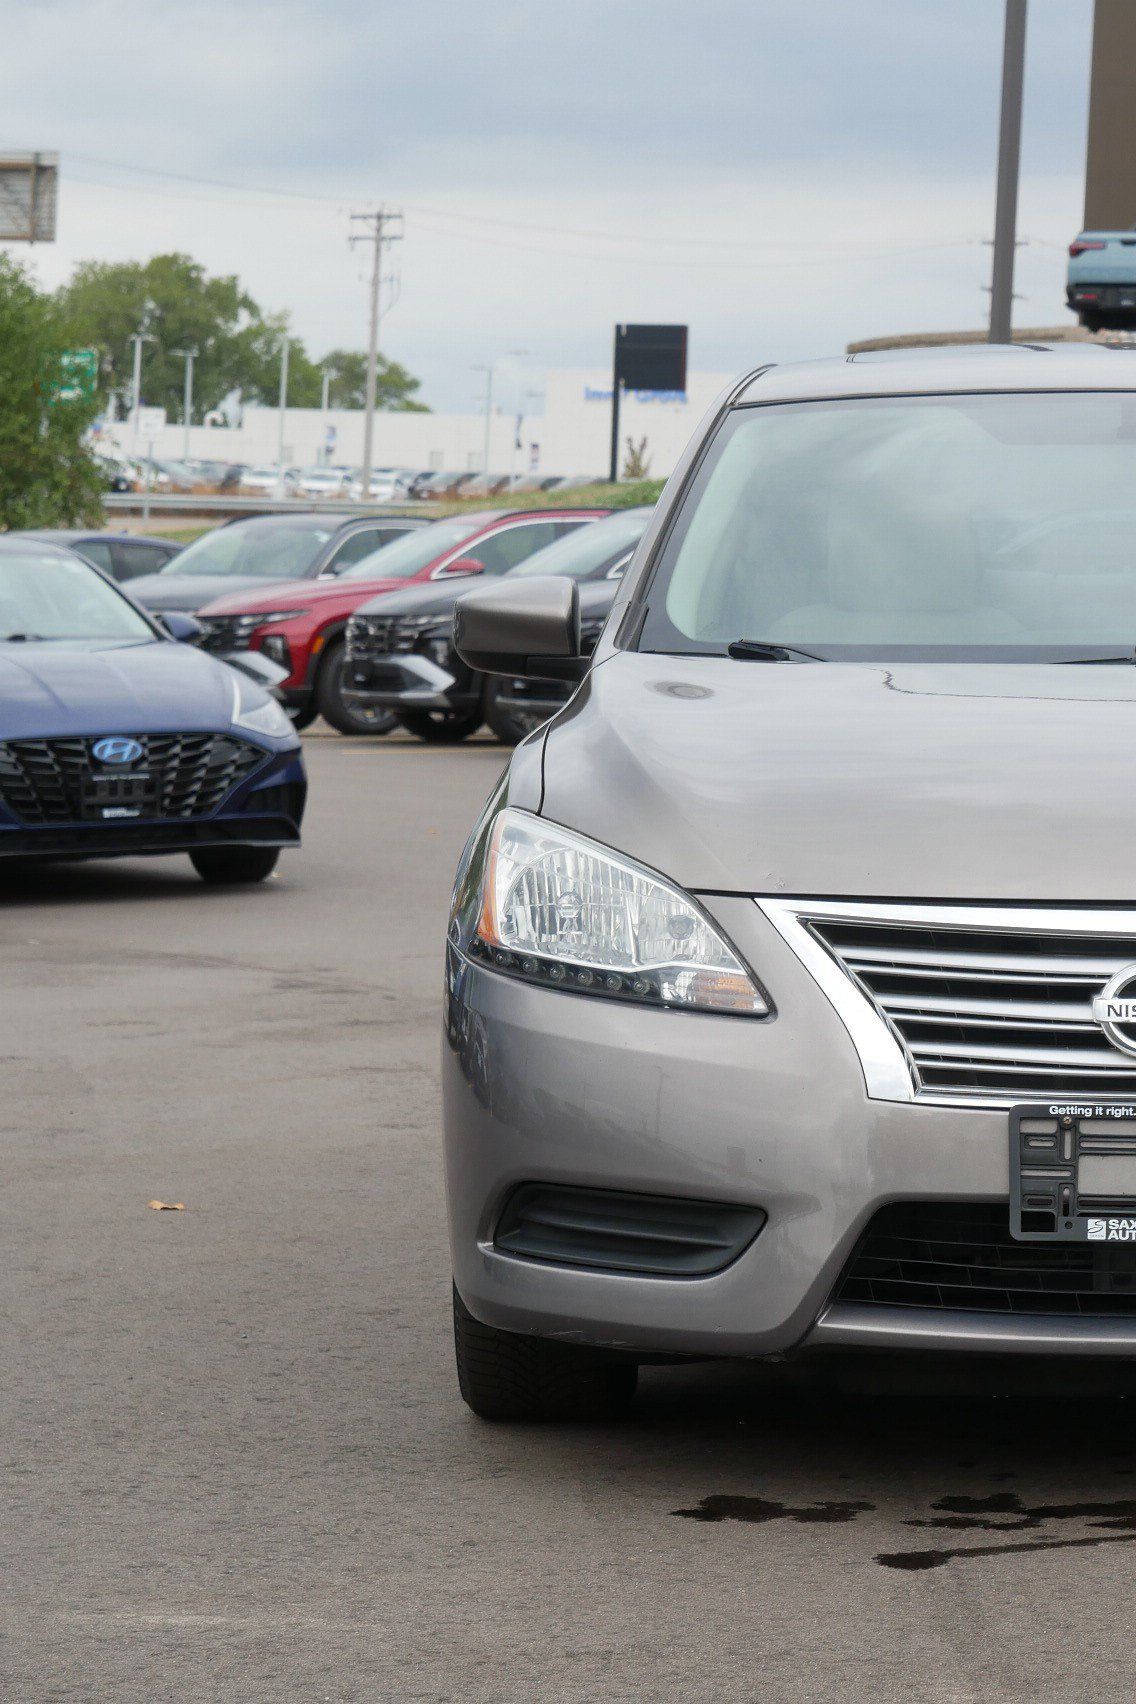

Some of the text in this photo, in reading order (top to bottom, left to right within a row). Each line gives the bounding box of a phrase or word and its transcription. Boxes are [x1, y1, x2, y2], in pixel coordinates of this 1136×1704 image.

[1049, 1105, 1092, 1117] Getting
[1095, 1106, 1103, 1116] it
[1106, 1107, 1136, 1118] right.
